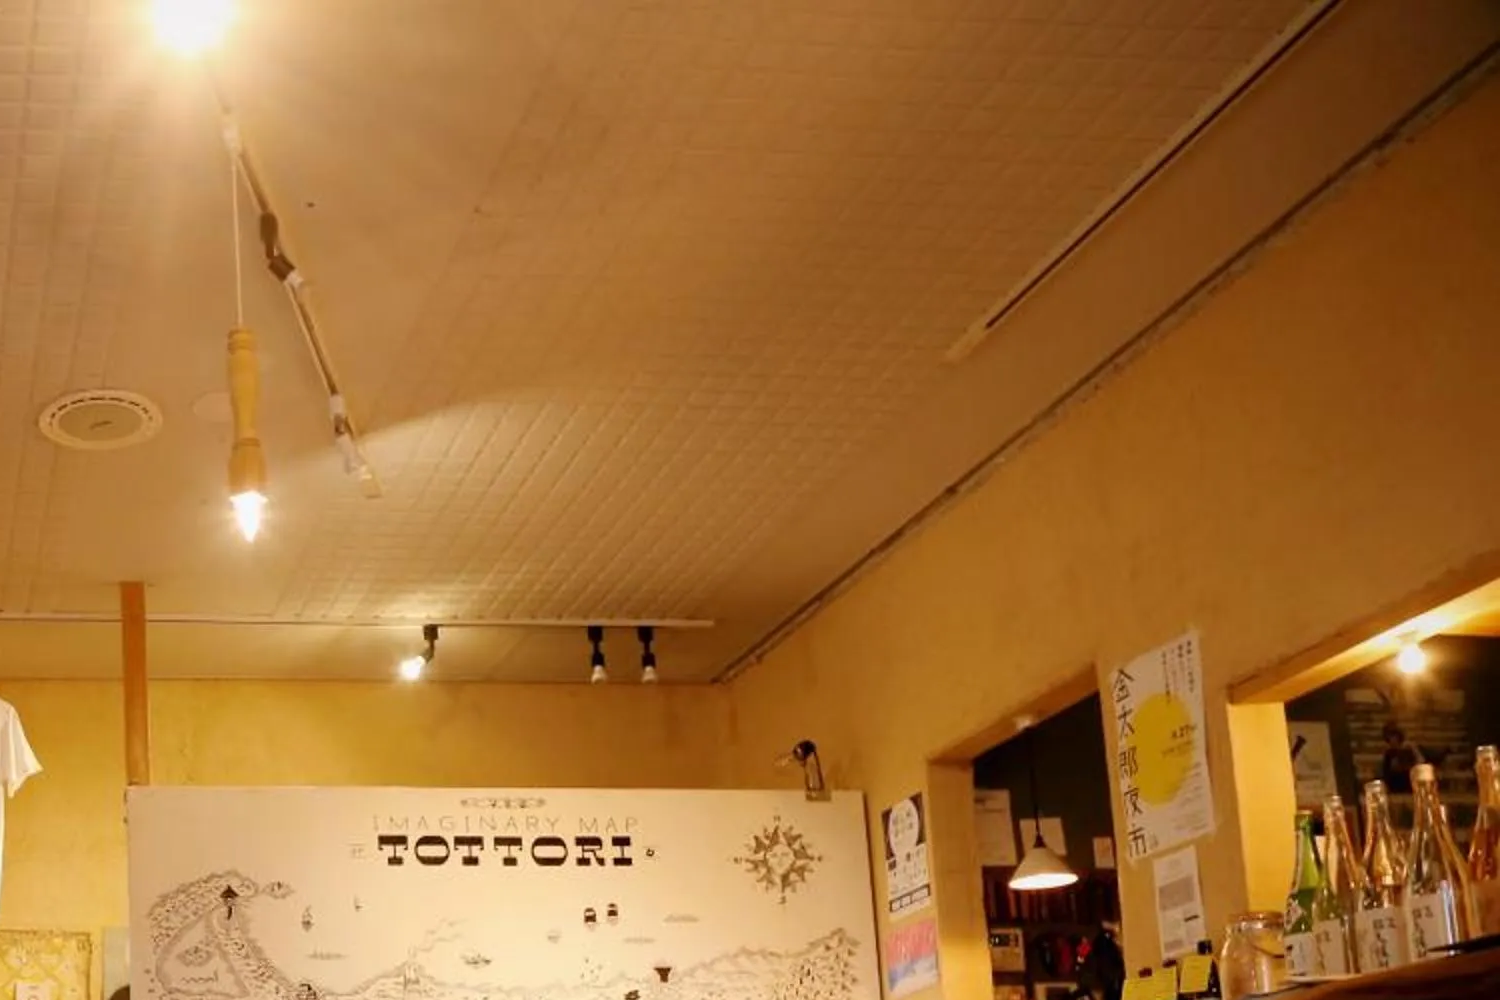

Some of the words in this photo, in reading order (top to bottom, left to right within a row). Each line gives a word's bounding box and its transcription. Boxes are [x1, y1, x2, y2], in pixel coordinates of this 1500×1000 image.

[372, 815, 561, 833] IMAGINARY
[578, 815, 640, 833] MAP
[376, 834, 634, 867] TOTTORI
